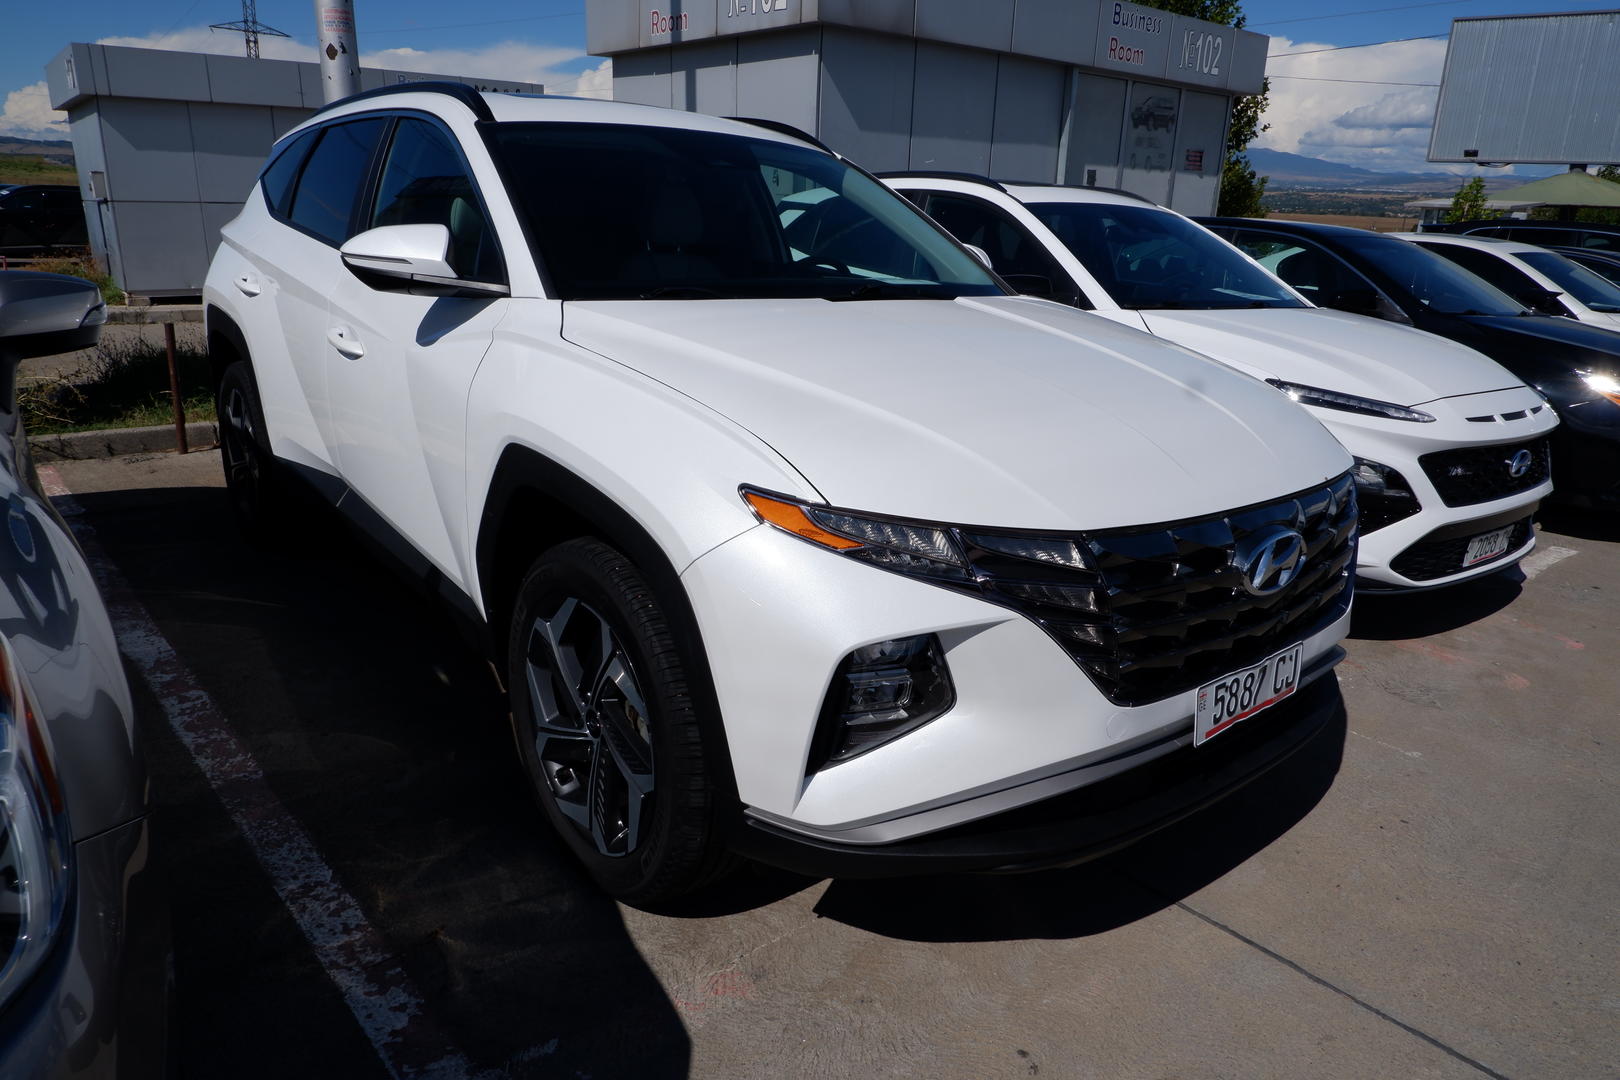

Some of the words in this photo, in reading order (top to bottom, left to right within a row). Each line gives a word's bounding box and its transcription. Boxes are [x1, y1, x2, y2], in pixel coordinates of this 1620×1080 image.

[650, 10, 689, 35] Room
[1112, 2, 1162, 34] Business
[1109, 37, 1144, 65] Room
[1212, 664, 1268, 726] 5887
[1273, 648, 1299, 695] CJ
